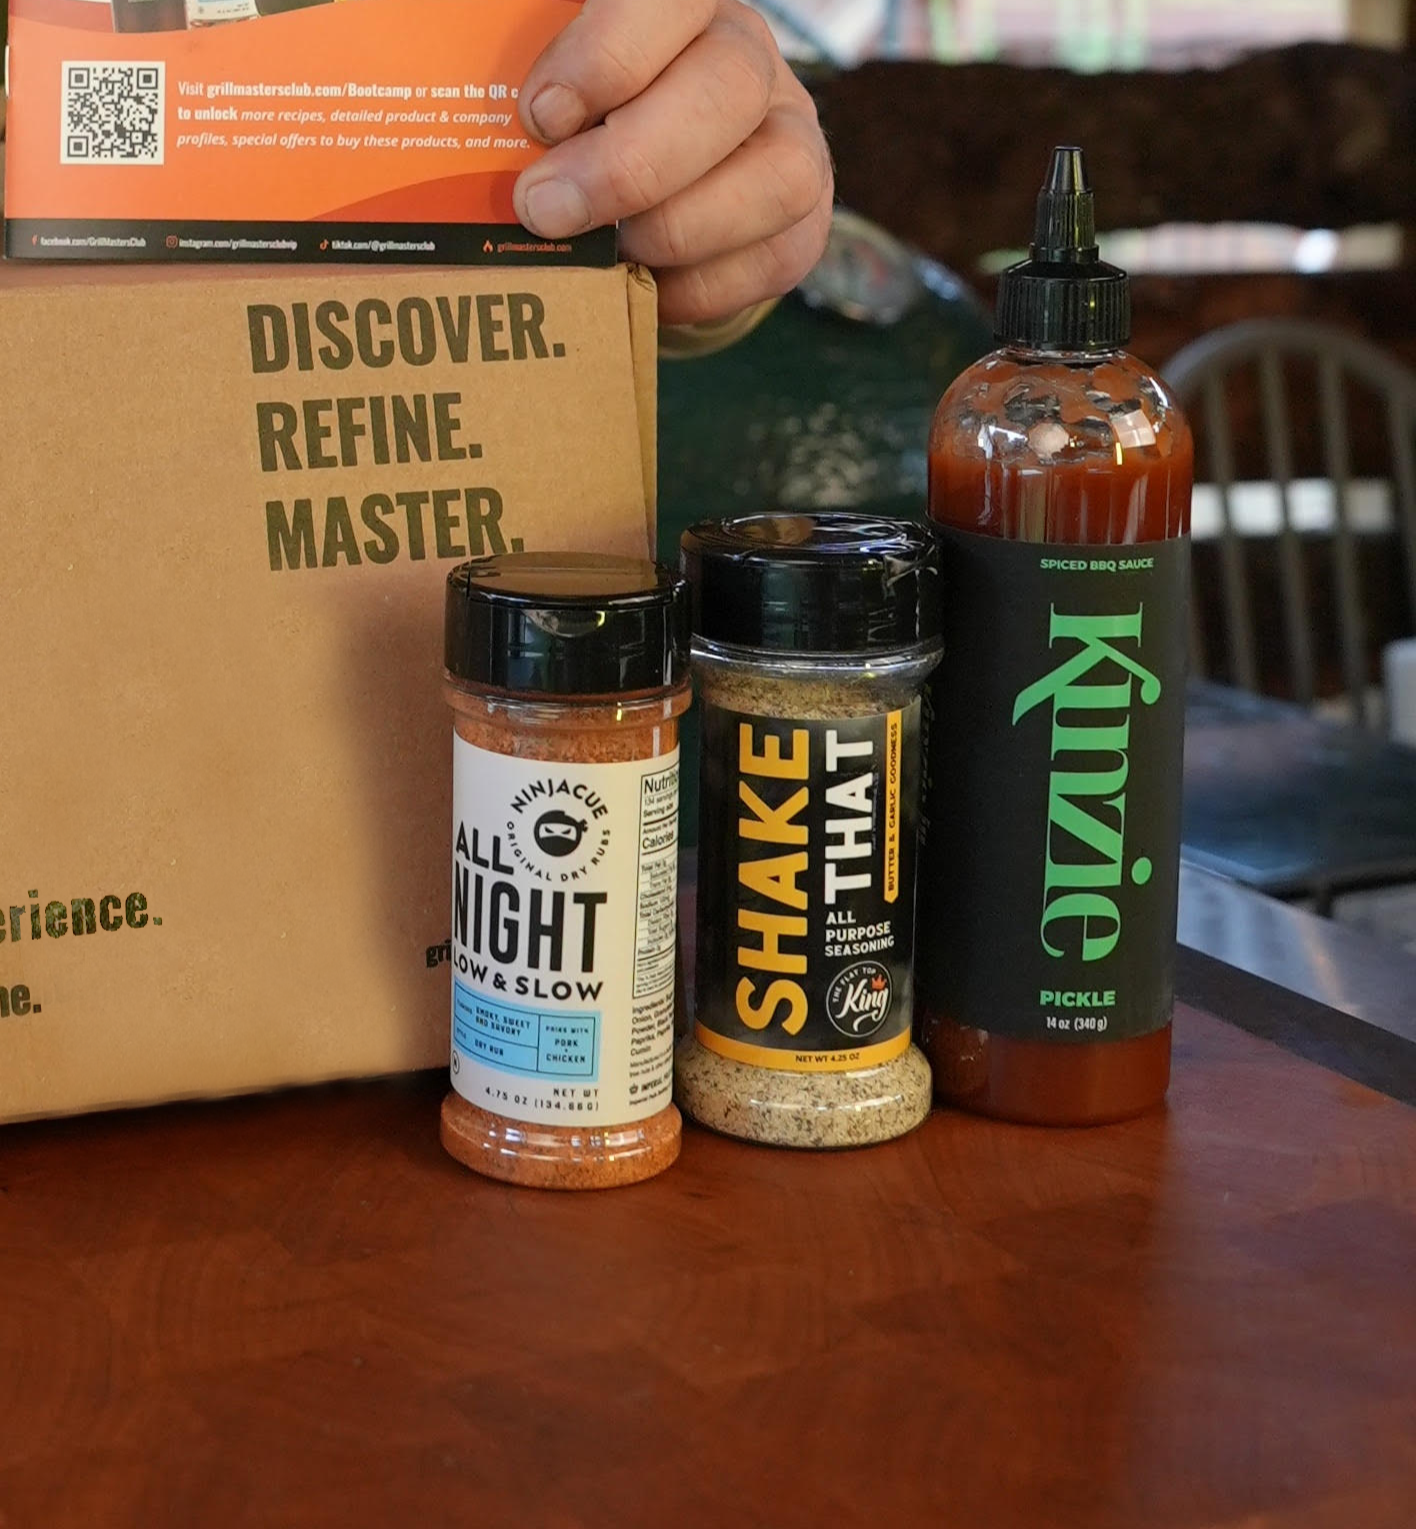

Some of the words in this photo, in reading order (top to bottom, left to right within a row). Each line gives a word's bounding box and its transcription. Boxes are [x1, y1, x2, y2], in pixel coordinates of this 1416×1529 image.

[178, 81, 203, 96] Visit
[207, 82, 412, 100] grillmastersclub.com/Bootcamp
[416, 86, 427, 97] or
[431, 86, 460, 98] scan
[464, 84, 485, 98] the
[488, 84, 507, 100] QR
[177, 106, 190, 120] to
[195, 106, 238, 120] unlock
[241, 110, 274, 121] more
[278, 109, 326, 124] recipes,
[330, 109, 383, 122] detailed
[385, 110, 435, 125] product
[439, 111, 449, 123] &
[452, 113, 512, 126] company
[176, 132, 228, 148] profiles,
[232, 133, 277, 148] special
[282, 133, 316, 149] offers
[320, 135, 333, 147] to
[337, 134, 361, 150] buy
[364, 134, 398, 147] these
[401, 135, 461, 150] products,
[465, 136, 491, 148] and
[493, 138, 530, 149] more.
[247, 292, 565, 373] DISCOVER.
[256, 392, 483, 471] REFINE.
[265, 486, 525, 571] MASTER.
[1040, 558, 1087, 570] SPICED
[1089, 560, 1116, 572] BBQ
[1118, 557, 1154, 570] SAUCE
[889, 722, 898, 784] GOODNESS
[1012, 601, 1161, 962] Kinzie
[510, 778, 608, 819] NINJACUE
[888, 788, 897, 829] GARLIC
[824, 729, 873, 905] THAT
[455, 821, 514, 875] ALL
[506, 821, 552, 881] ORIGINAL
[560, 866, 587, 882] DRY
[591, 829, 611, 865] RUBS
[642, 831, 674, 850] Calories
[735, 722, 810, 1036] SHAKE
[887, 847, 896, 892] BUTTER
[454, 860, 607, 973] NIGHT
[825, 910, 857, 925] ALL
[825, 920, 891, 943] PURPOSE
[824, 935, 895, 957] SEASONING
[453, 945, 488, 983] LOW
[492, 972, 507, 992] &
[515, 976, 603, 1001] SLOW
[832, 986, 842, 1003] THE
[840, 968, 859, 986] FLAT
[862, 966, 877, 975] TOP
[835, 978, 889, 1032] King
[1039, 990, 1116, 1007] PICKLE
[1046, 1016, 1057, 1029] 14
[1058, 1019, 1071, 1030] oz
[1074, 1016, 1096, 1031] (340
[1097, 1015, 1108, 1032] g)
[474, 1038, 487, 1050] DRY
[554, 1038, 578, 1047] PORK
[795, 1055, 812, 1063] NET
[815, 1055, 828, 1063] WT
[830, 1054, 847, 1062] 4.25
[849, 1052, 860, 1061] OZ
[546, 1053, 586, 1064] CHICKEN
[485, 1086, 508, 1101] 4.75
[514, 1095, 528, 1105] OZ
[553, 1088, 576, 1097] NET
[583, 1088, 599, 1098] WT
